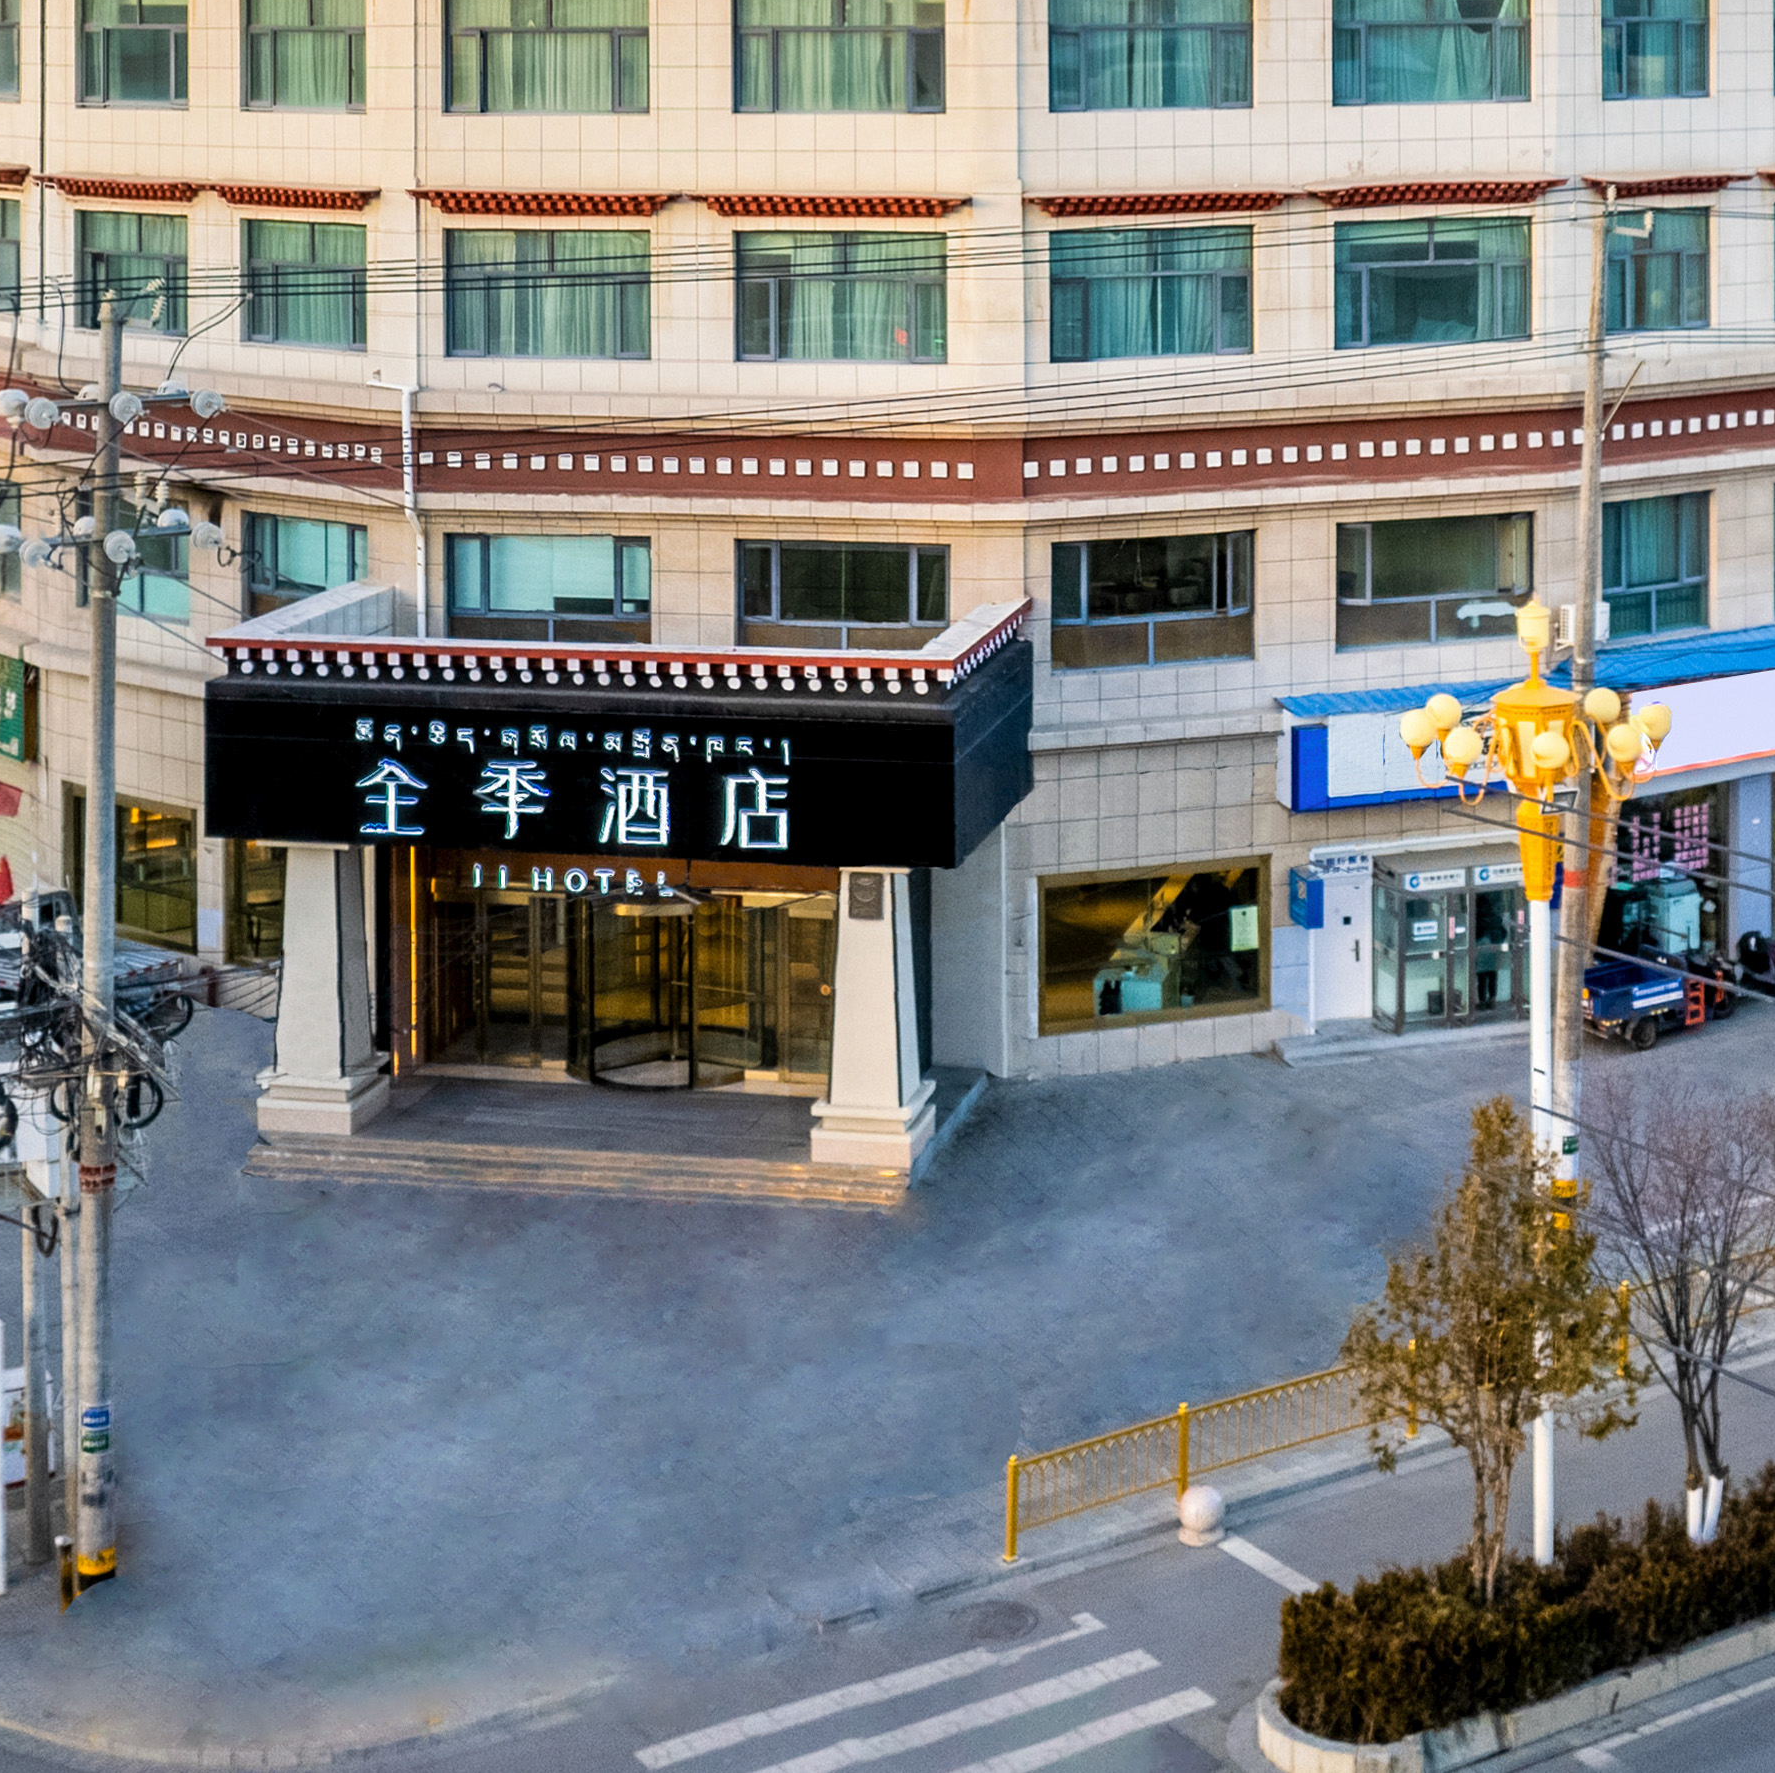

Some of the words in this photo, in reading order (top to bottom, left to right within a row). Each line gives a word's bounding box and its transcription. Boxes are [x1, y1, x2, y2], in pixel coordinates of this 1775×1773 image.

[355, 757, 790, 850] 全季酒店
[531, 865, 675, 898] HOTEL
